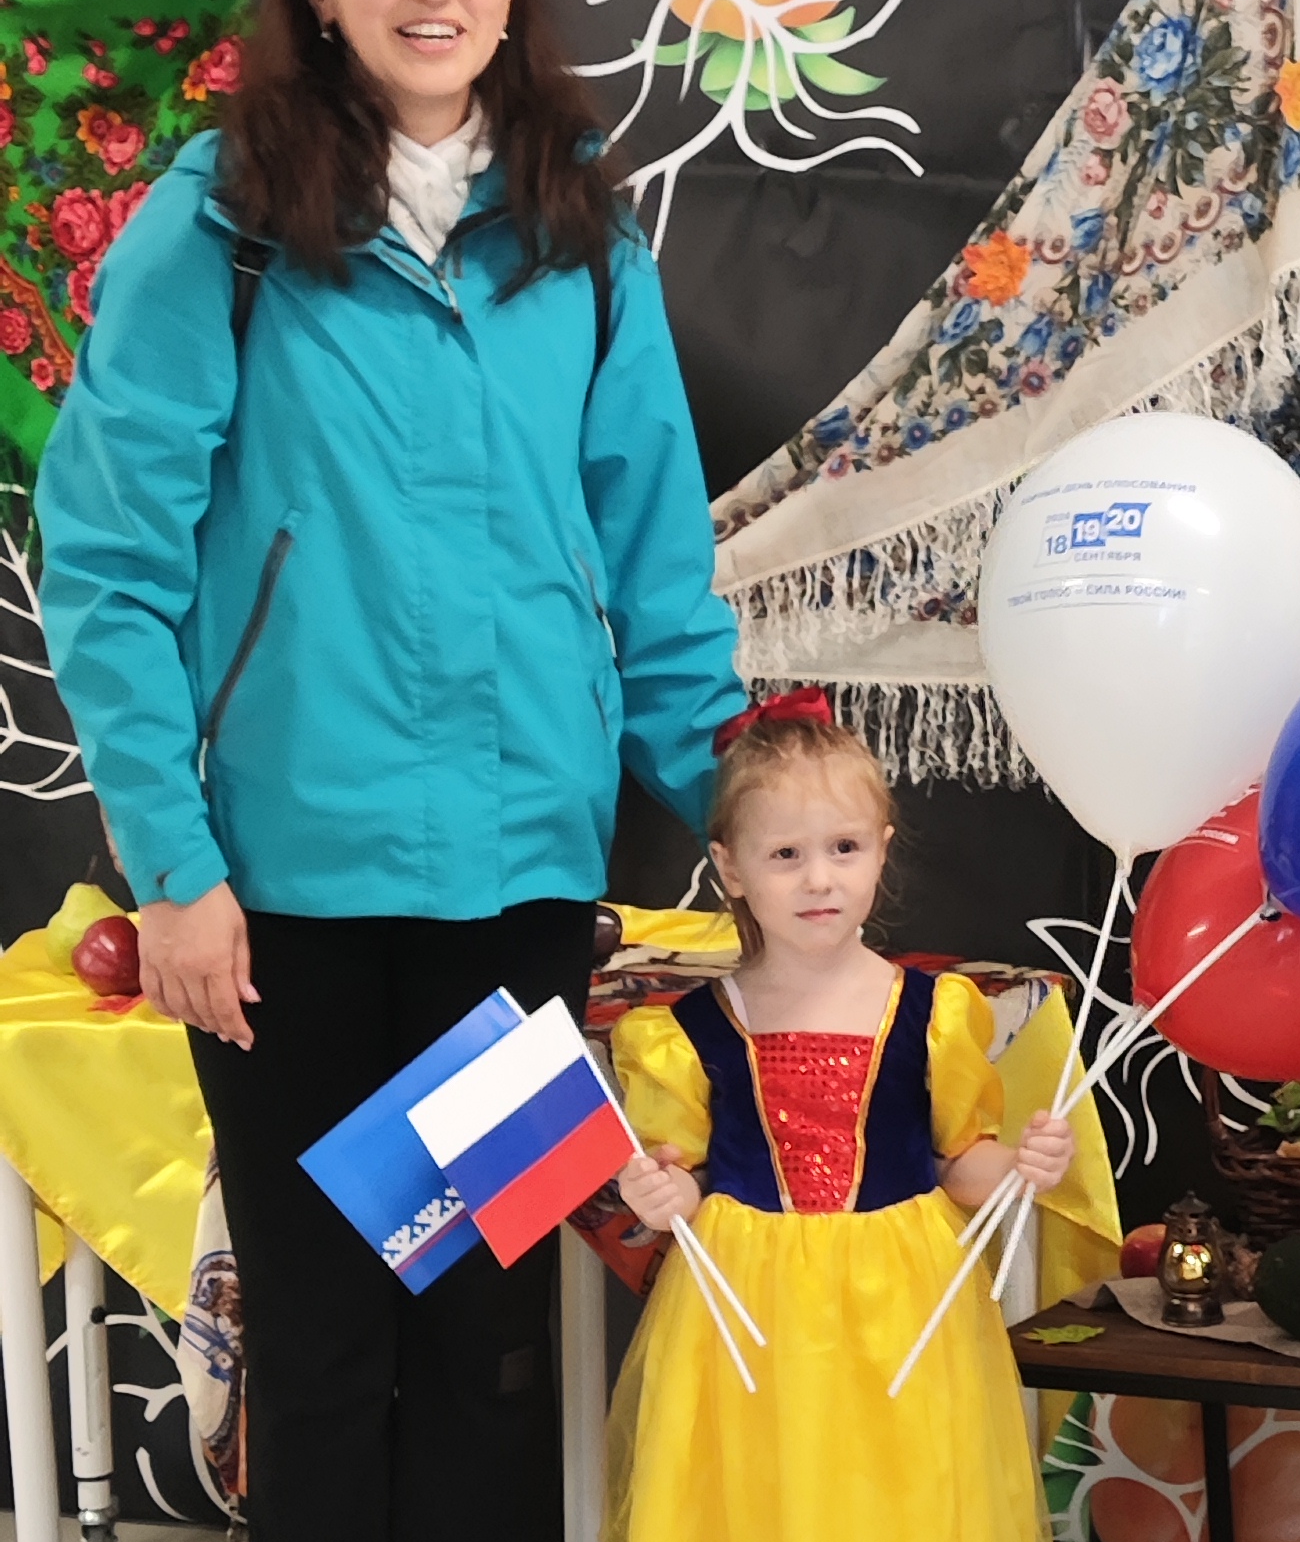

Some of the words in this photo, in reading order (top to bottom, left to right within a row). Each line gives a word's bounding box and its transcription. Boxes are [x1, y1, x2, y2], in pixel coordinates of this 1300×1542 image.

[1073, 519, 1100, 542] 19
[1106, 509, 1142, 531] 20
[1045, 534, 1068, 556] 18
[1073, 551, 1141, 562] СЕНТЯБРЯ
[1086, 583, 1120, 596] СИЛА
